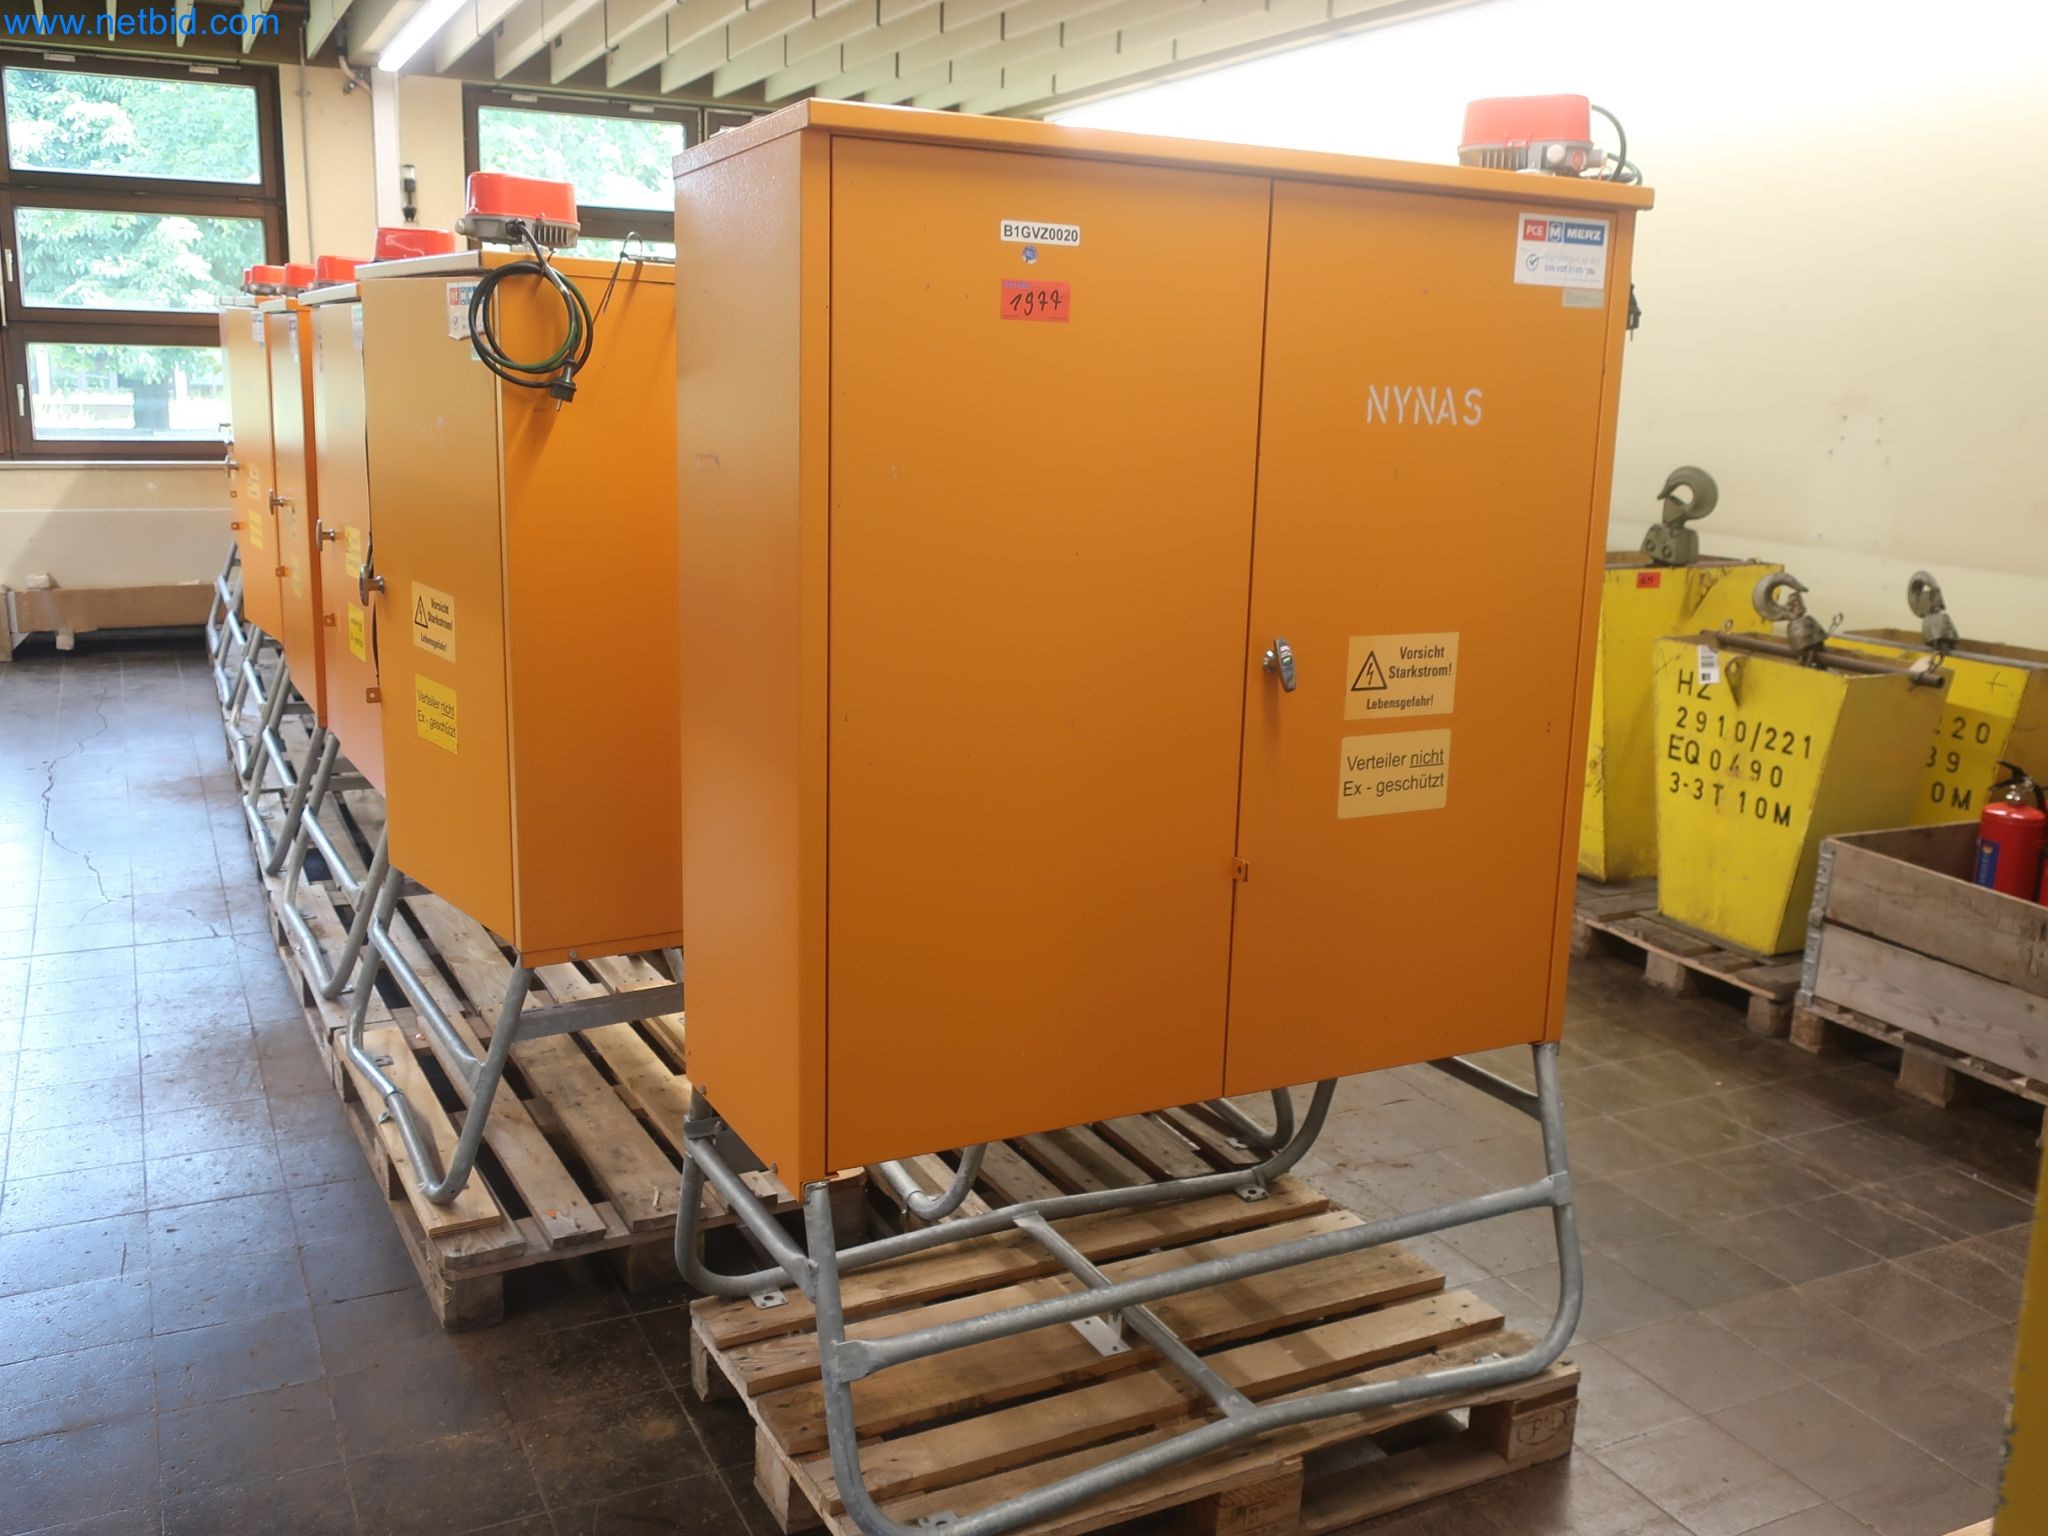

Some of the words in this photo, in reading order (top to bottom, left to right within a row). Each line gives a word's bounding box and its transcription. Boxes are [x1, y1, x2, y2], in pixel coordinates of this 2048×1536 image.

[1003, 224, 1079, 242] B1GVZ0020
[1566, 227, 1602, 241] MERZ
[1366, 384, 1484, 426] NYNAS
[1400, 645, 1445, 660] Vorsicht
[1388, 663, 1452, 680] Starkstrom!
[1366, 695, 1434, 710] Lebensgefahr!
[1676, 706, 1812, 760] 2910/221
[1347, 752, 1407, 771] Verteiler
[1409, 749, 1445, 766] nicht
[1343, 780, 1363, 797] Ex
[1376, 773, 1445, 797] geschützt
